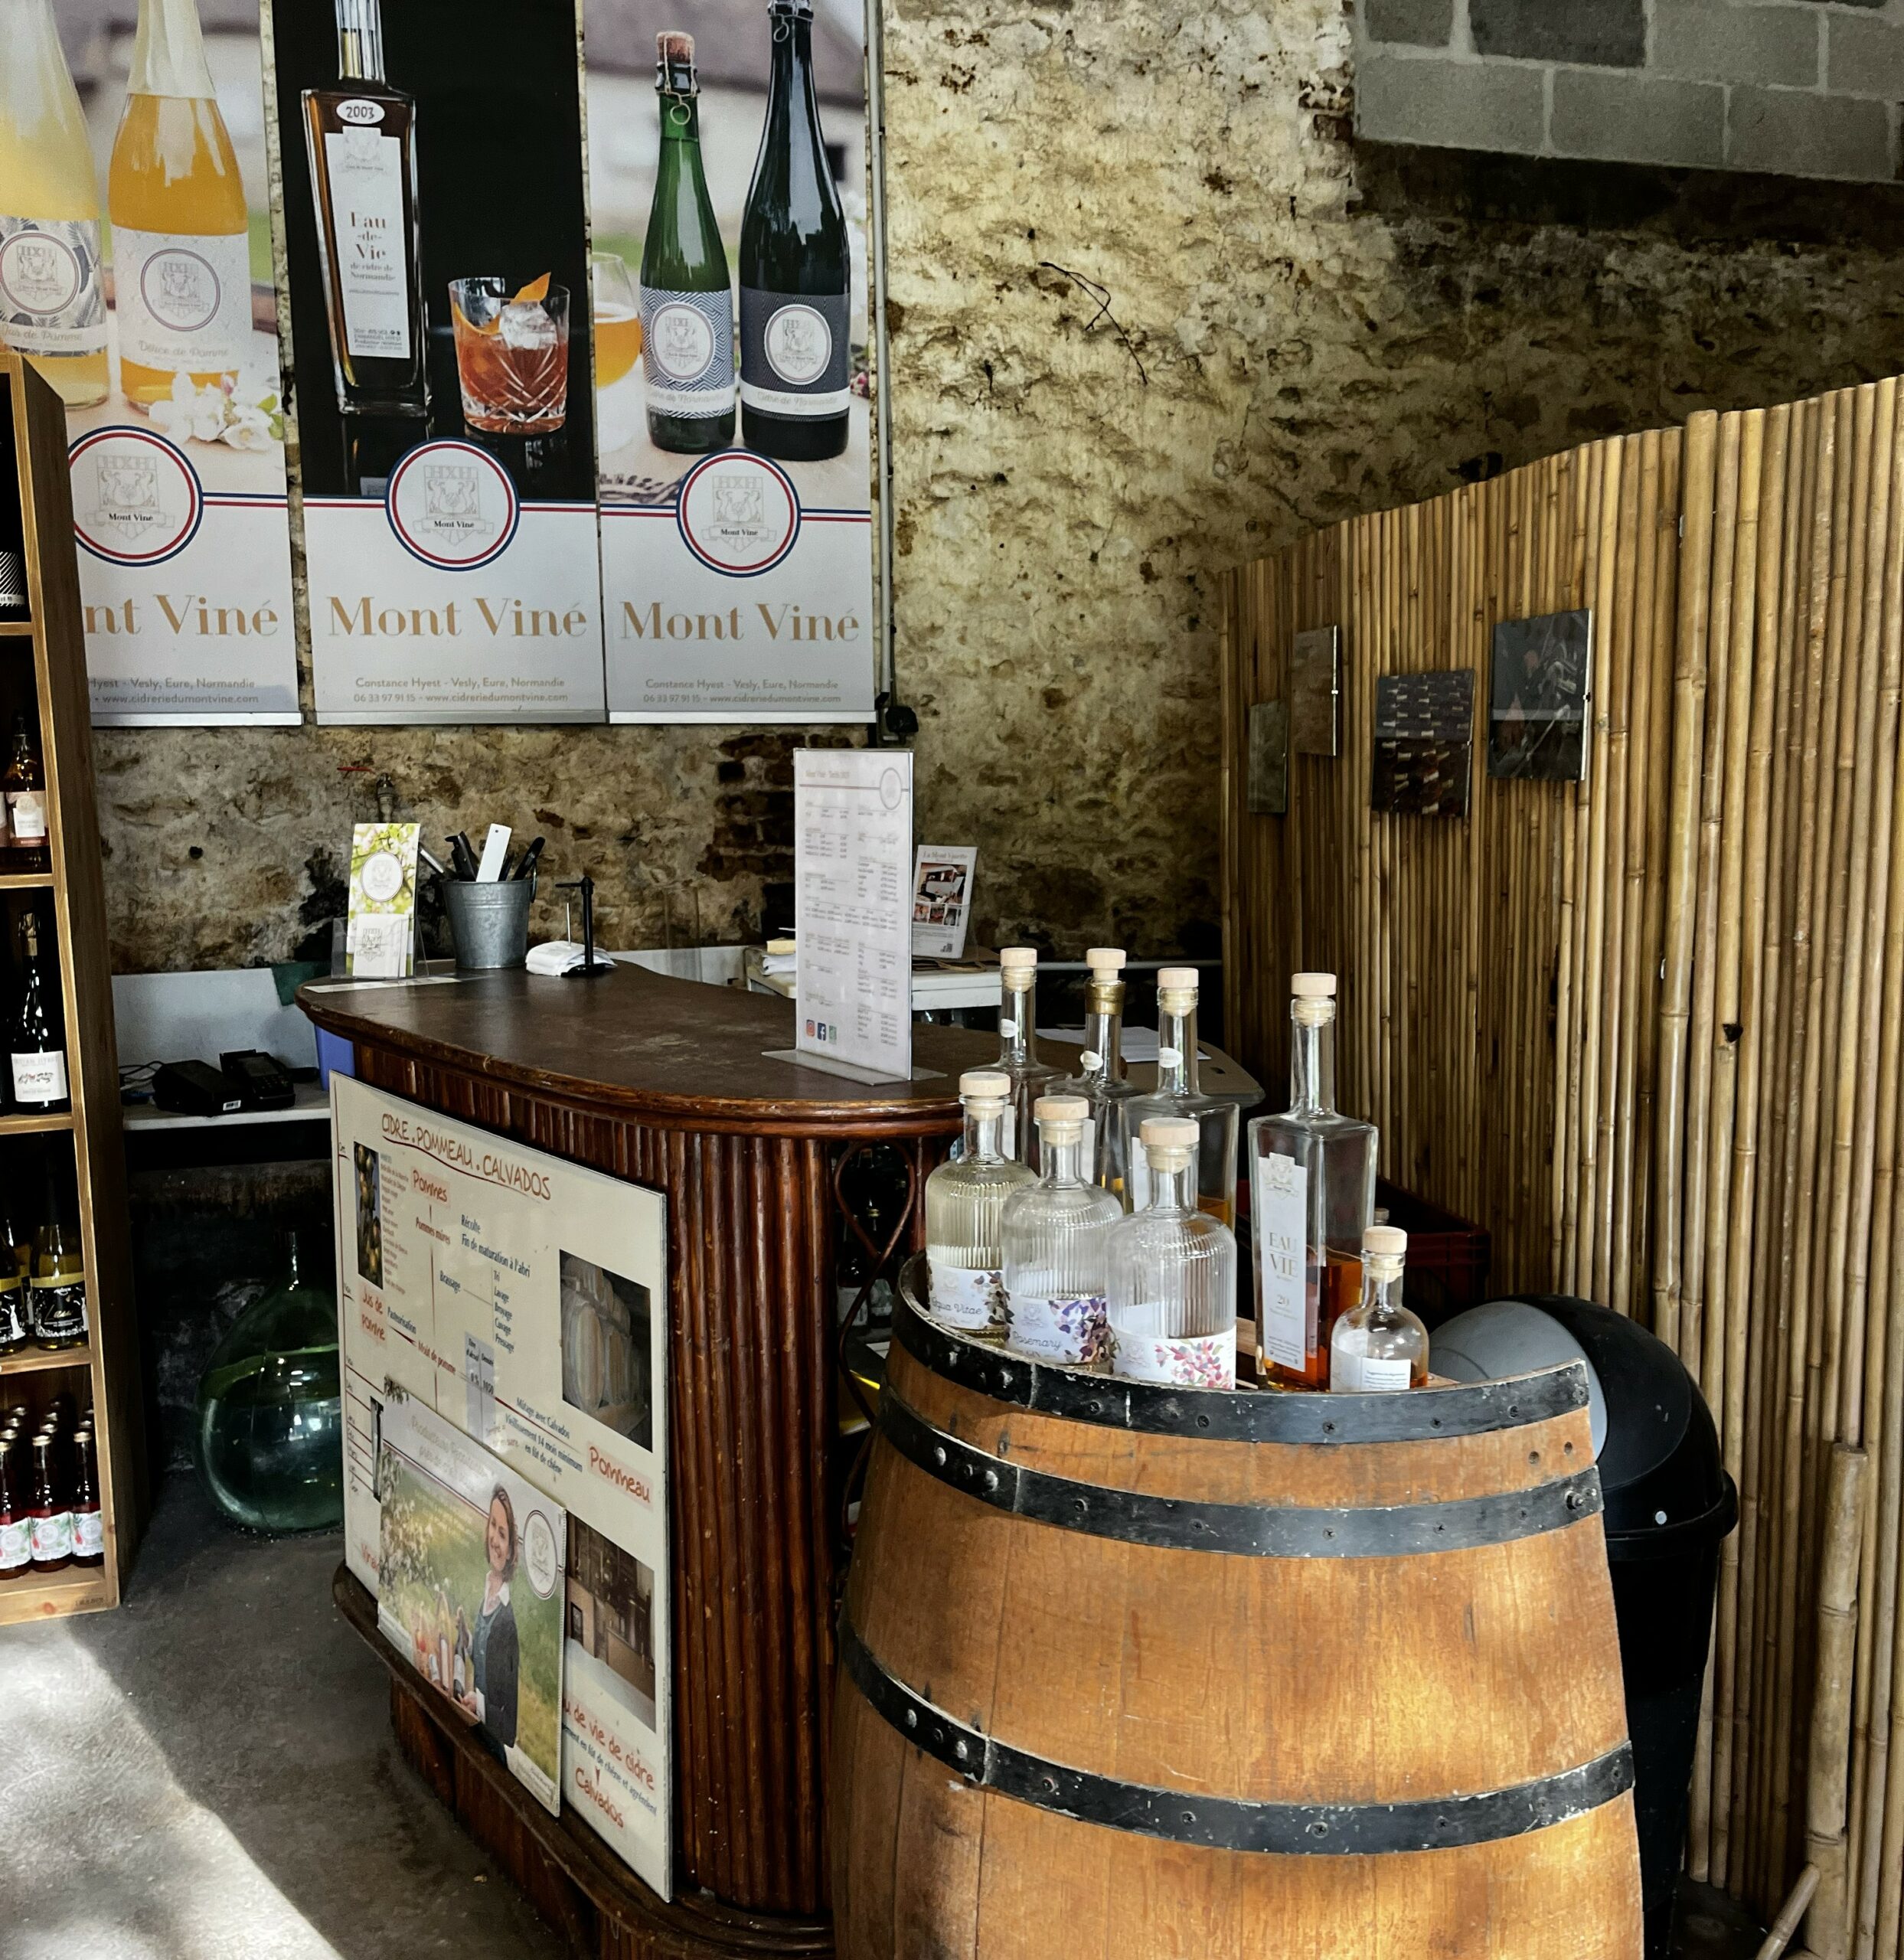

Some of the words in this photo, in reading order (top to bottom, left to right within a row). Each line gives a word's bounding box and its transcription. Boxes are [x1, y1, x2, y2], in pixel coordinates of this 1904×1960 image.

[345, 106, 374, 119] 2003
[109, 513, 131, 521] Mont
[83, 598, 142, 635] nt
[153, 594, 279, 637] Viné
[326, 596, 462, 637] Mont
[472, 597, 587, 637] Viné
[619, 601, 745, 640] Mont
[755, 603, 860, 642] Viné
[165, 678, 194, 690] Eure,
[196, 678, 255, 688] Normandie
[355, 677, 409, 688] Constance
[411, 678, 442, 691] Hyest
[450, 677, 480, 690] Vesly,
[482, 678, 508, 689] Eure,
[511, 677, 565, 688] Normandie
[645, 678, 694, 689] Constance
[697, 679, 724, 692] Hyest
[763, 679, 787, 691] Eure,
[789, 679, 838, 690] Normandie
[354, 693, 366, 703] 06
[368, 693, 380, 703] 33
[381, 693, 394, 703] 97
[426, 692, 568, 703] www.cidreriedumontvine.com
[483, 1154, 551, 1200] CALVADOS
[461, 1214, 481, 1234] Récolte
[462, 1233, 470, 1248] Fin
[470, 1237, 478, 1252] de
[478, 1243, 508, 1269] maturation
[1269, 1231, 1297, 1253] EAU
[1270, 1253, 1299, 1278] VIE
[953, 1303, 983, 1315] Vitae
[1012, 1331, 1063, 1351] Rosemary
[505, 1413, 537, 1442] Vieillissement
[537, 1435, 544, 1447] 14
[545, 1442, 557, 1456] mois
[547, 1416, 570, 1439] Calvados
[589, 1446, 651, 1504] Pommeau
[574, 1704, 587, 1730] de
[589, 1719, 606, 1747] vie
[609, 1735, 622, 1762] de
[625, 1750, 655, 1792] cidre
[575, 1766, 625, 1828] Calvados
